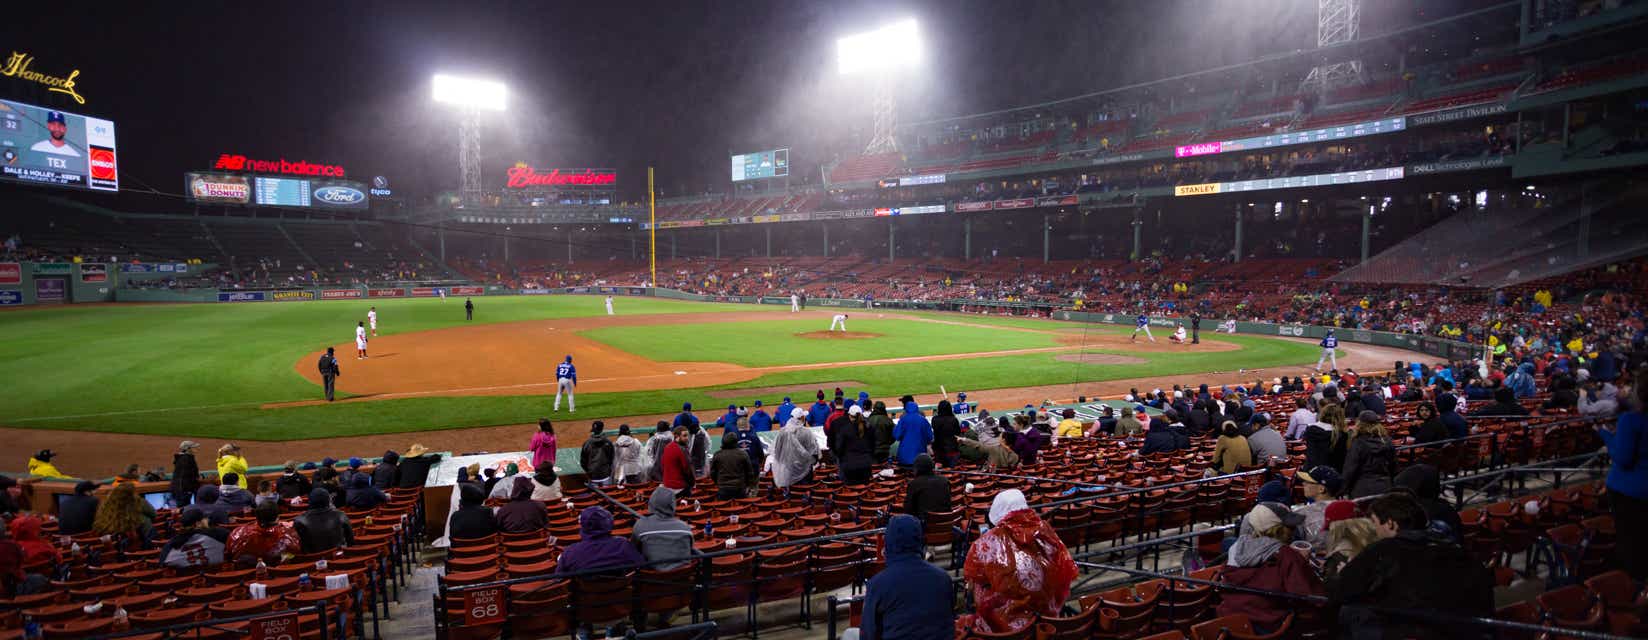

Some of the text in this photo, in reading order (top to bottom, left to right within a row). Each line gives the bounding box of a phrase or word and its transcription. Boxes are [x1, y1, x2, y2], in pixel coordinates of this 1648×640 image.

[2, 51, 85, 104] Hancock
[1438, 111, 1464, 122] STREET
[1466, 104, 1506, 118] PAVILION
[6, 120, 17, 129] 32
[47, 157, 66, 169] TEX
[4, 166, 23, 175] DALE
[30, 169, 55, 178] HOLLEY
[1413, 164, 1435, 173] DELL
[507, 167, 616, 188] Budweiser
[209, 190, 245, 198] DONUTS
[370, 188, 391, 196] tyco
[1180, 184, 1215, 194] STANLEY
[325, 190, 354, 202] Ford
[559, 367, 569, 376] 27
[471, 589, 498, 598] FIELD
[475, 596, 496, 605] BOX
[471, 604, 499, 619] 68
[261, 618, 290, 628] FIELD
[264, 625, 287, 633] BOX
